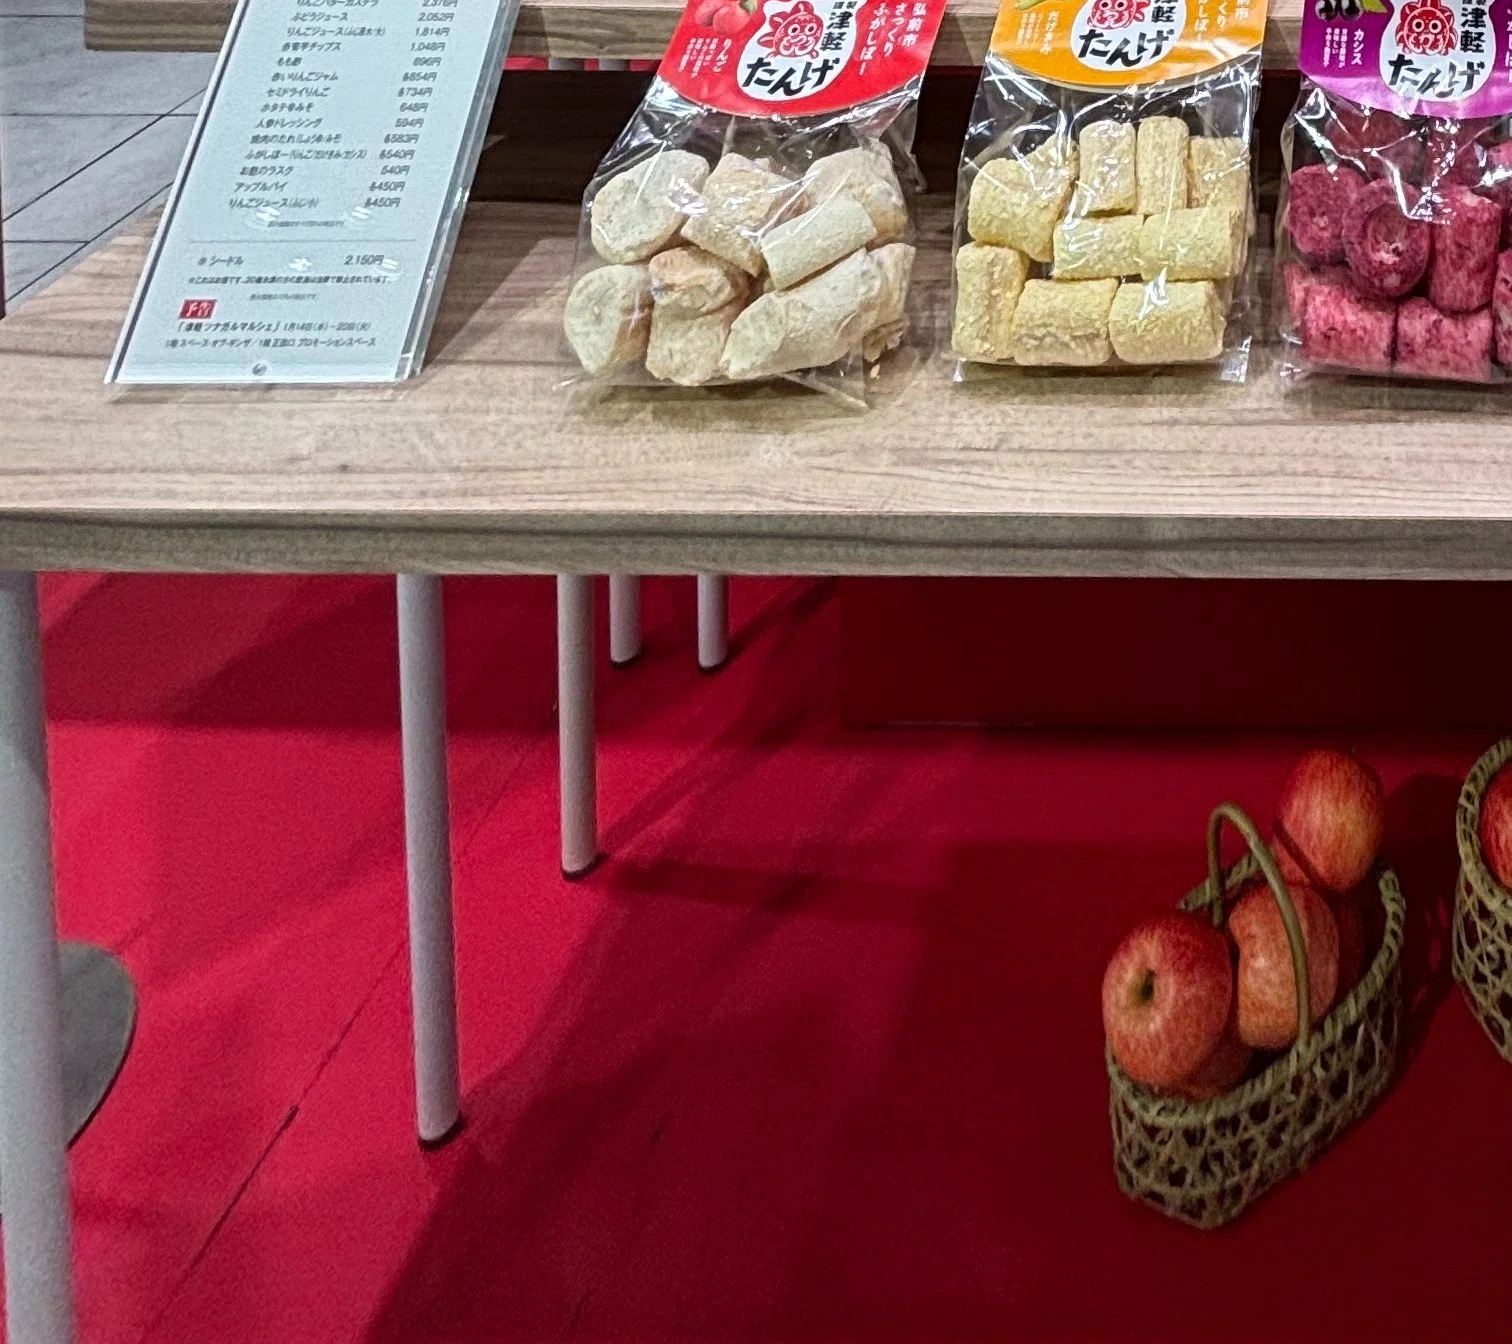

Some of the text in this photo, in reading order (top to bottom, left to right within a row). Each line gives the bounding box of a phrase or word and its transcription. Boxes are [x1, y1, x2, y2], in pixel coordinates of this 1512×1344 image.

[819, 11, 854, 52] 津軽
[858, 1, 890, 76] ふがしぼー
[882, 3, 908, 58] さっくり
[901, 2, 927, 48] 弘前市
[1077, 28, 1174, 68] たんげ
[1350, 28, 1365, 66] カシス
[1459, 6, 1487, 54] 津軽
[742, 57, 840, 98] たんげ
[1388, 53, 1485, 99] たんげ
